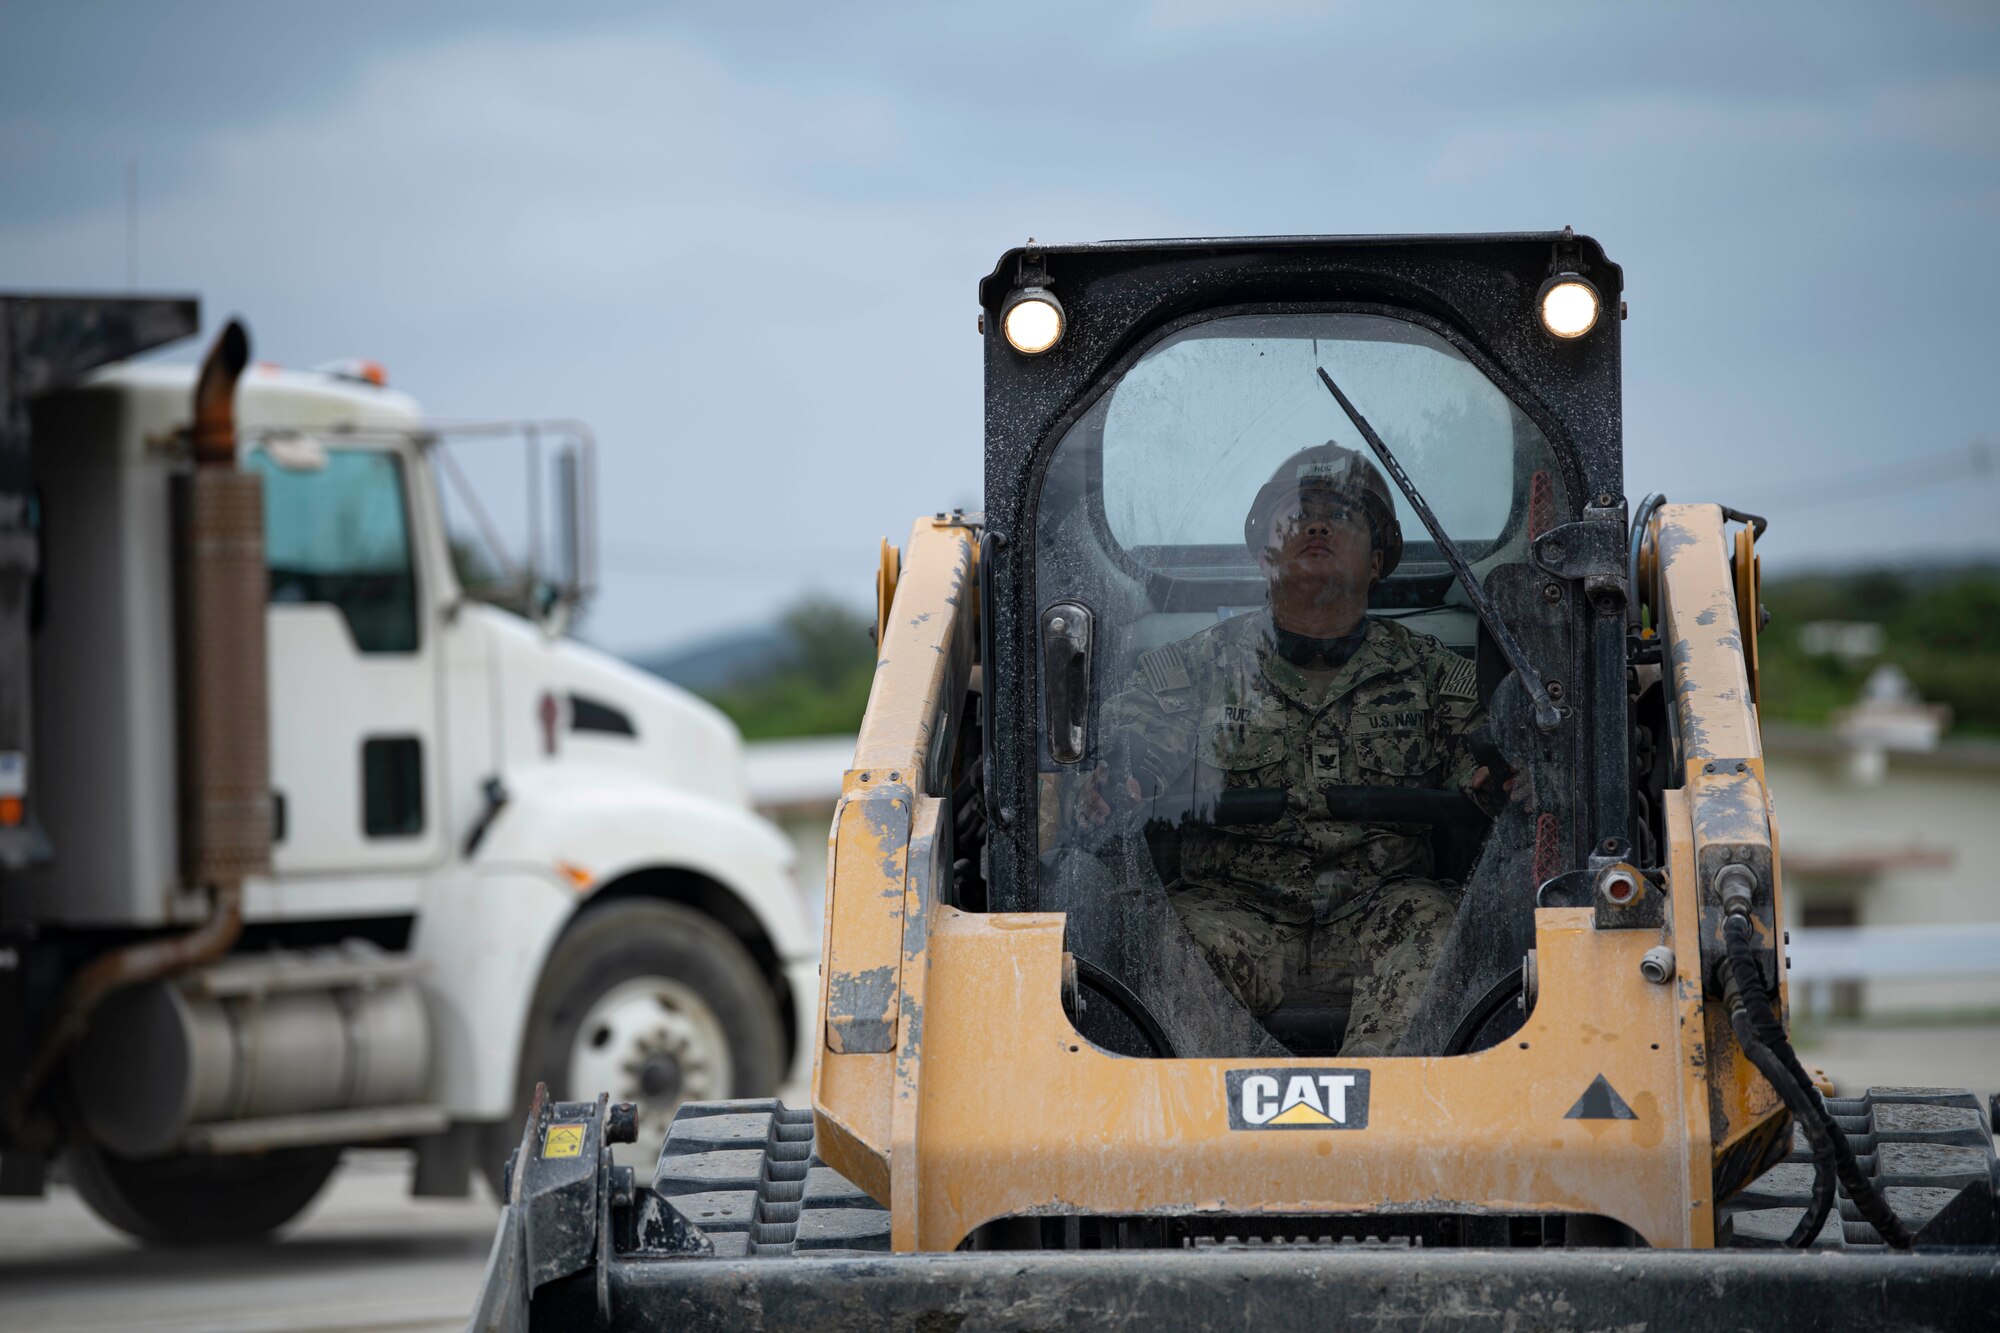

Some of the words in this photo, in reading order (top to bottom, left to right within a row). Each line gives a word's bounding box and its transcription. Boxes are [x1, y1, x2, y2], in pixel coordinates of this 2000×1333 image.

[1224, 706, 1251, 722] RUIZ
[1369, 714, 1393, 728] U.S.
[1394, 713, 1424, 727] NAVY
[1242, 1075, 1355, 1124] CAT
